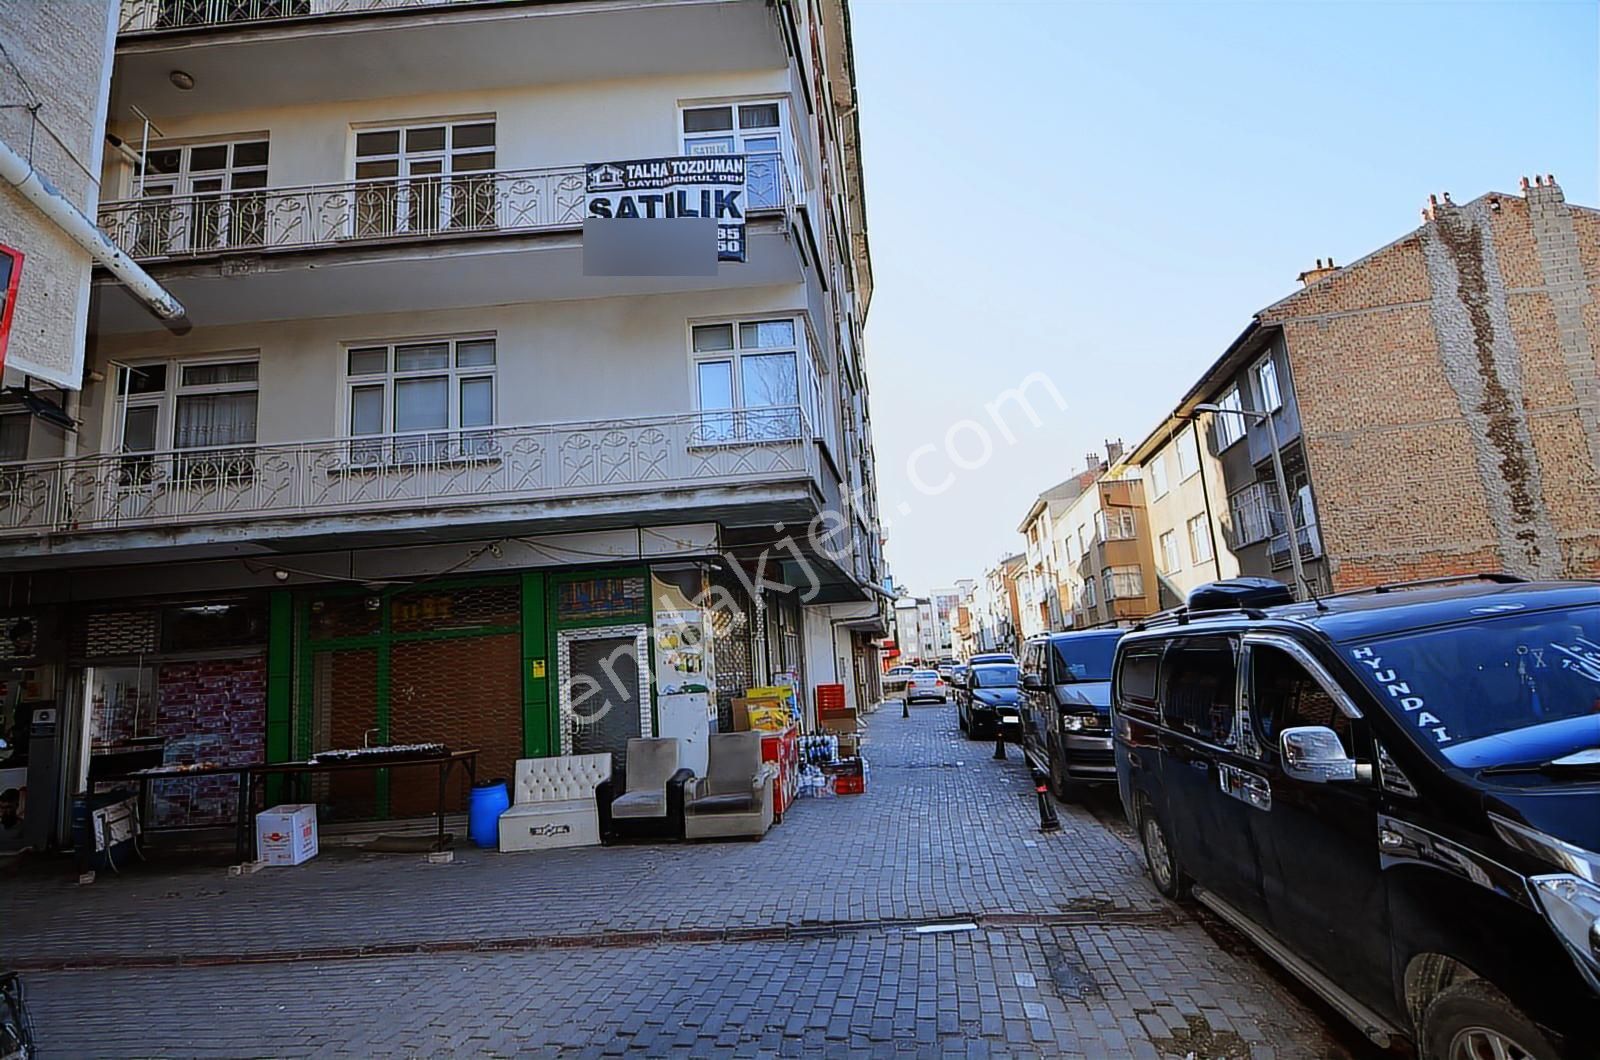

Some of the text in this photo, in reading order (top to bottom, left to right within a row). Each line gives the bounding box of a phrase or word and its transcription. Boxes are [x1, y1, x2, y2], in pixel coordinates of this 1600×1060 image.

[626, 159, 743, 179] TALHA TOZDUMAN
[588, 189, 743, 219] SATILIK
[1353, 646, 1452, 743] HYUNDAI
